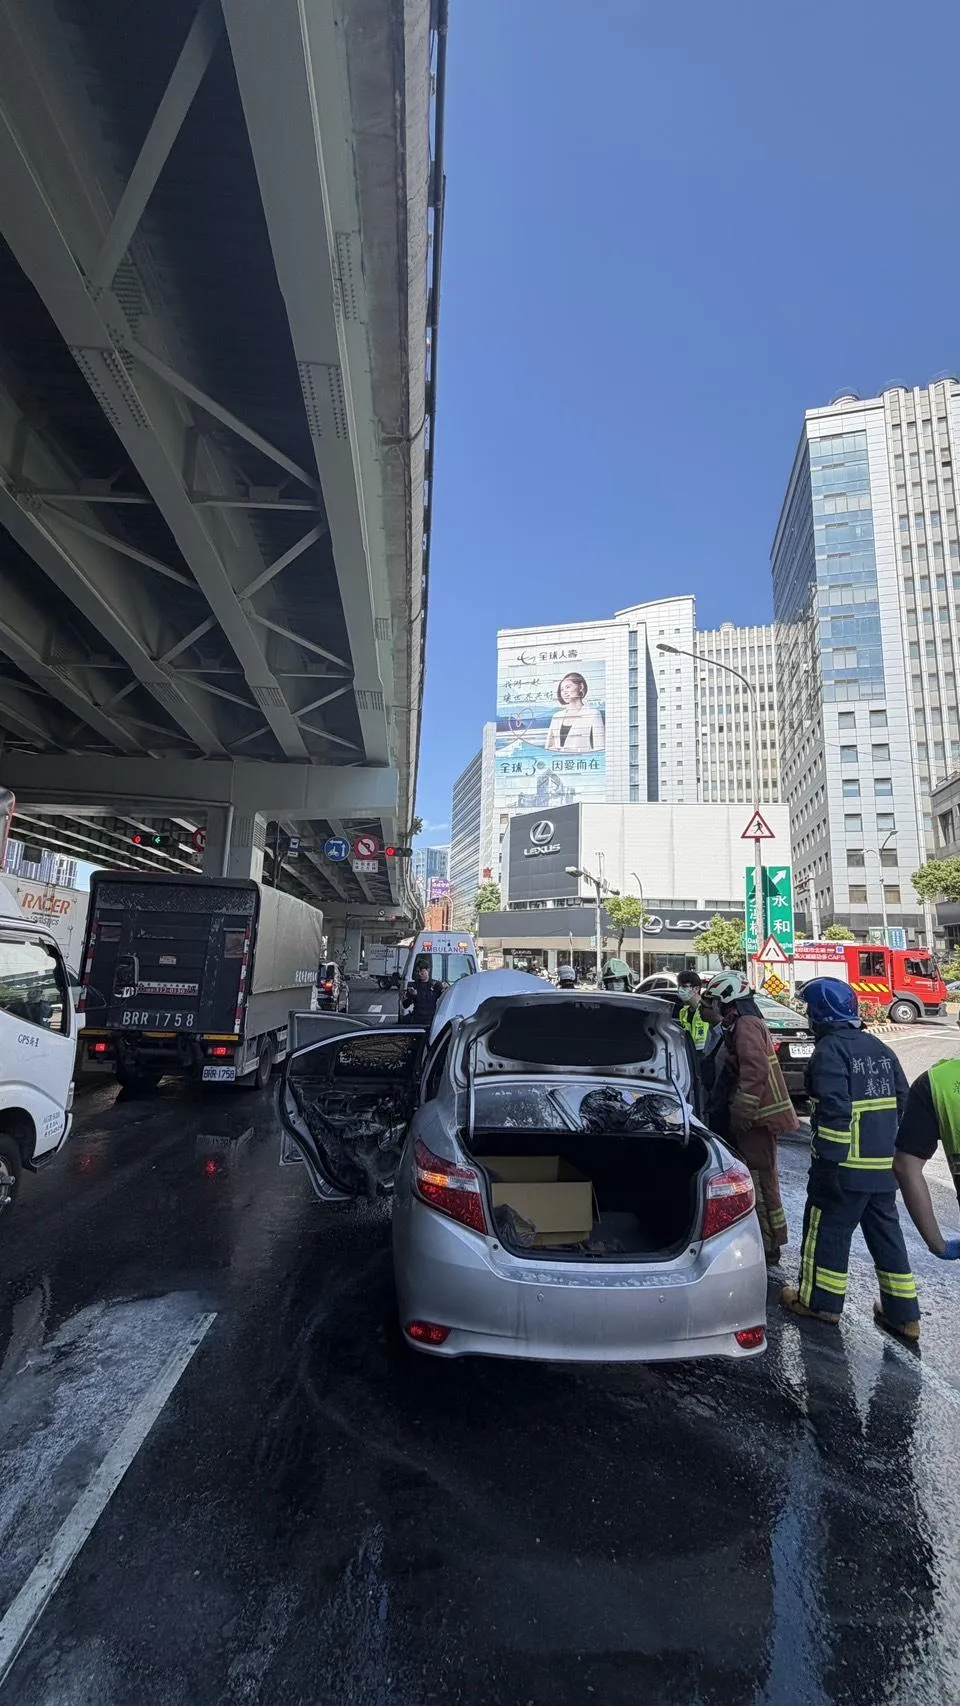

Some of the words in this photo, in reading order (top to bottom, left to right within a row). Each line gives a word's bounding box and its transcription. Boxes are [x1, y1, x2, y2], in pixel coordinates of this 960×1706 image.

[539, 649, 578, 661] 全球人壽
[500, 762, 523, 774] 全球
[551, 759, 600, 771] 因愛而在
[523, 843, 561, 856] LEXUS
[771, 892, 791, 935] 永和
[664, 919, 715, 931] LEX
[122, 1011, 149, 1025] BRR
[154, 1012, 194, 1027] 1758
[851, 1055, 892, 1076] 新北市
[864, 1077, 892, 1097] 義消
